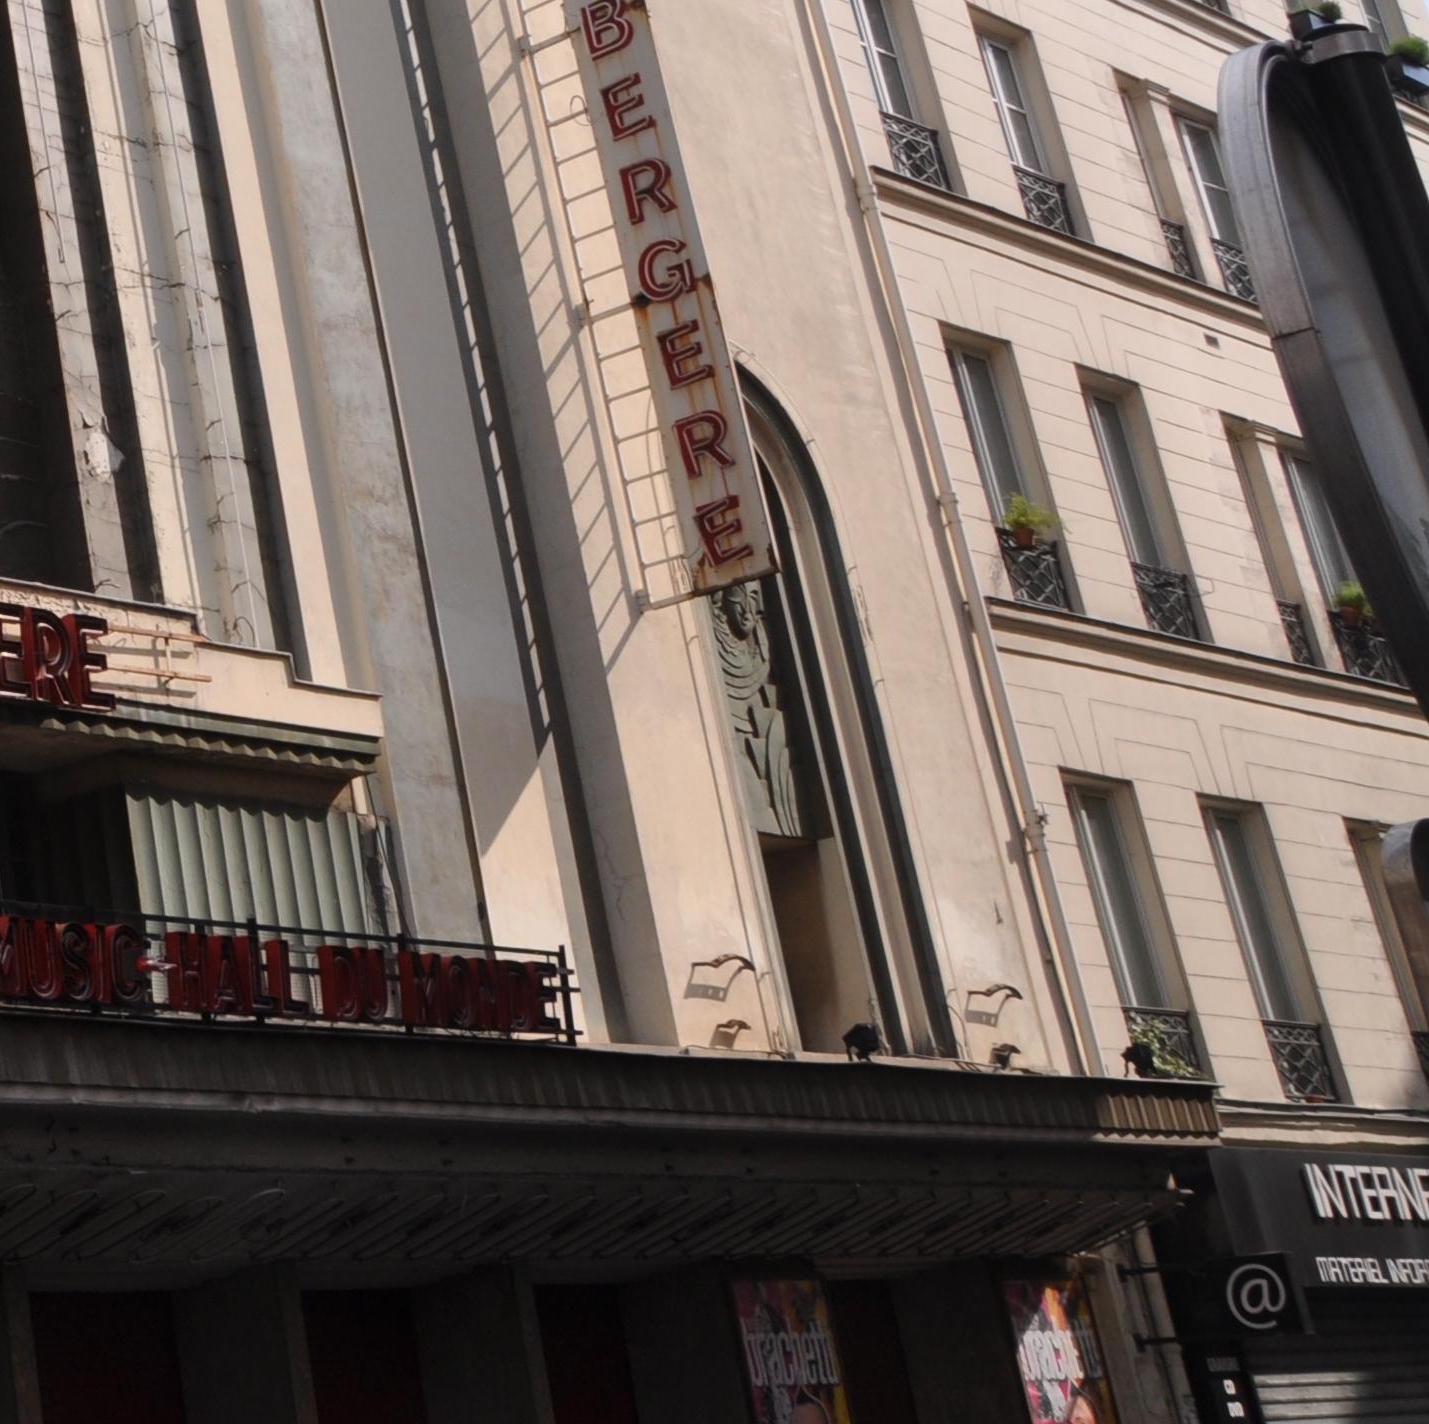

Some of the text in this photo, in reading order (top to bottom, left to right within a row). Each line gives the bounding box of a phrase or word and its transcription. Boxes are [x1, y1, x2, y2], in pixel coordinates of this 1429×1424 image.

[317, 945, 389, 1022] DU
[398, 950, 562, 1033] MONDE
[1226, 1263, 1286, 1330] @
